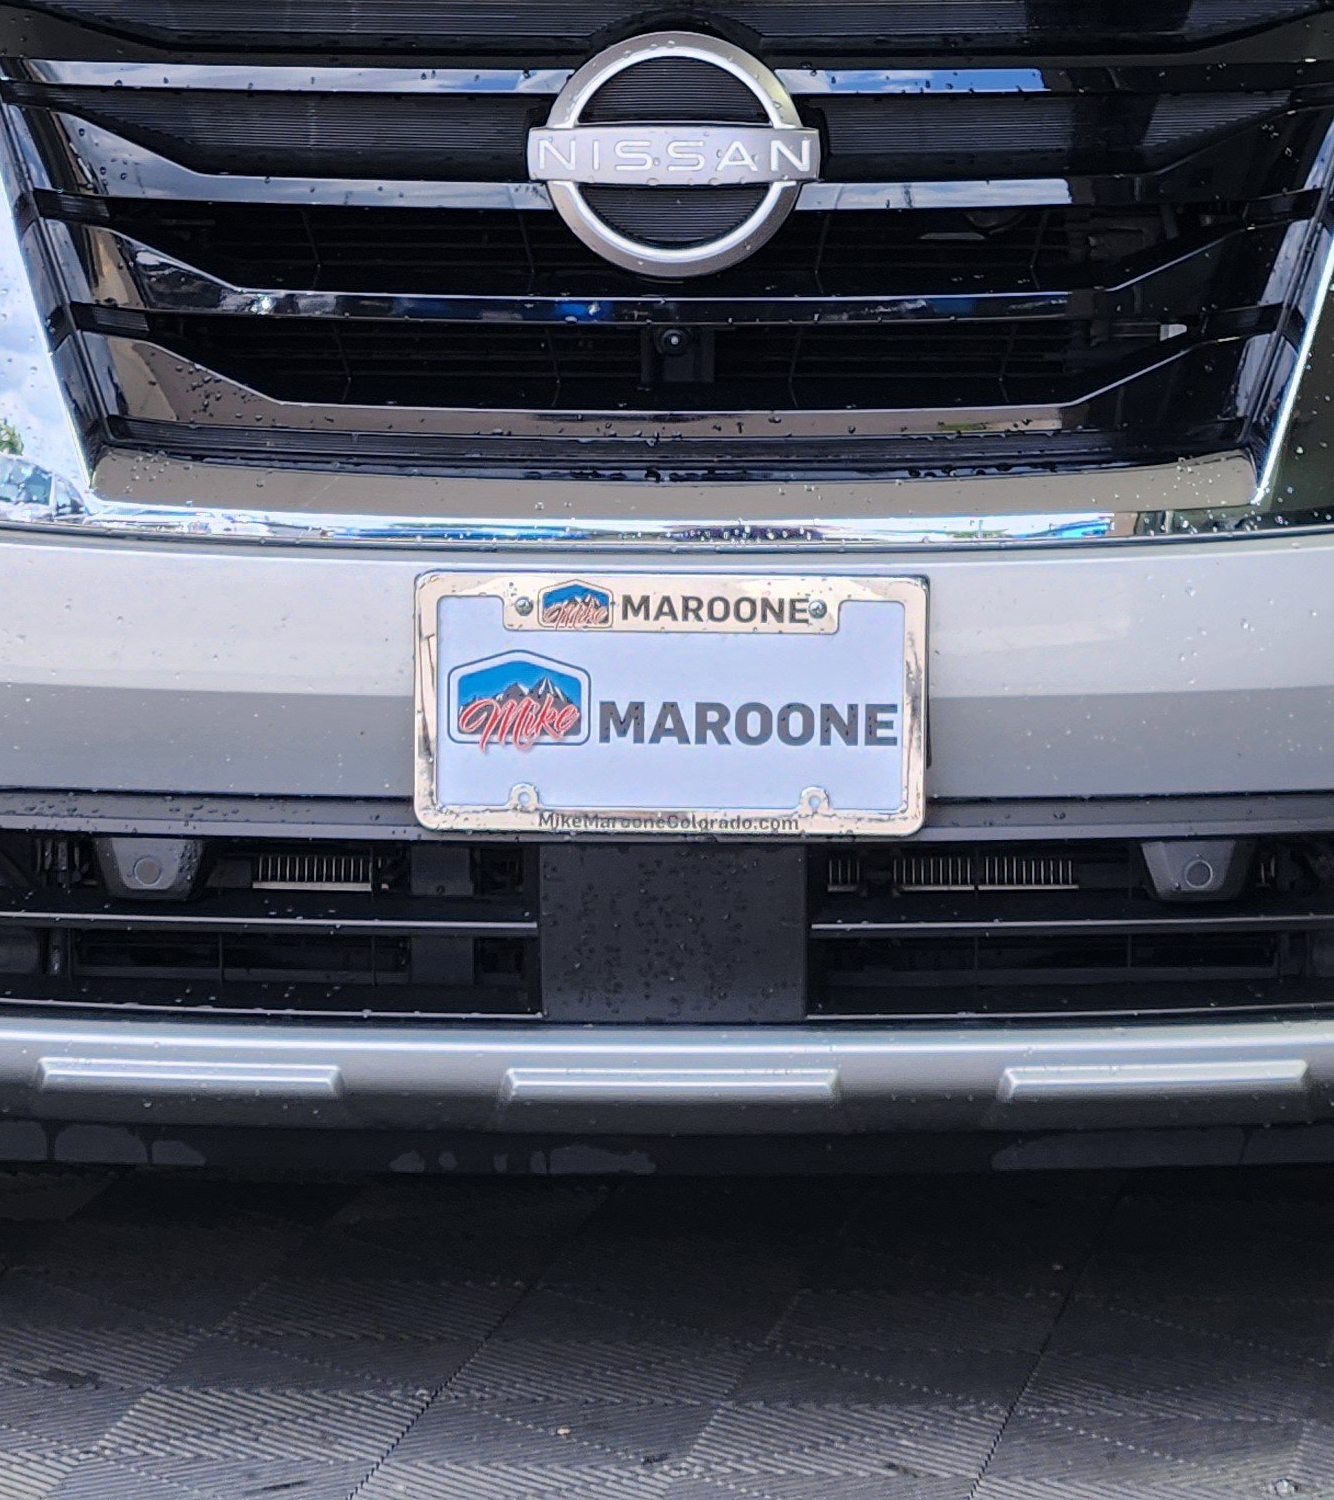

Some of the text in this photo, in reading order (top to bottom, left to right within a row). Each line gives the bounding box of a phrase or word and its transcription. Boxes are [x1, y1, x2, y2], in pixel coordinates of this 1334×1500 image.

[538, 139, 811, 172] NISSAN
[542, 594, 810, 630] Mike MAROONE
[459, 694, 898, 752] Mike MAROONE
[538, 811, 800, 832] MikeMarooneColorado.com
